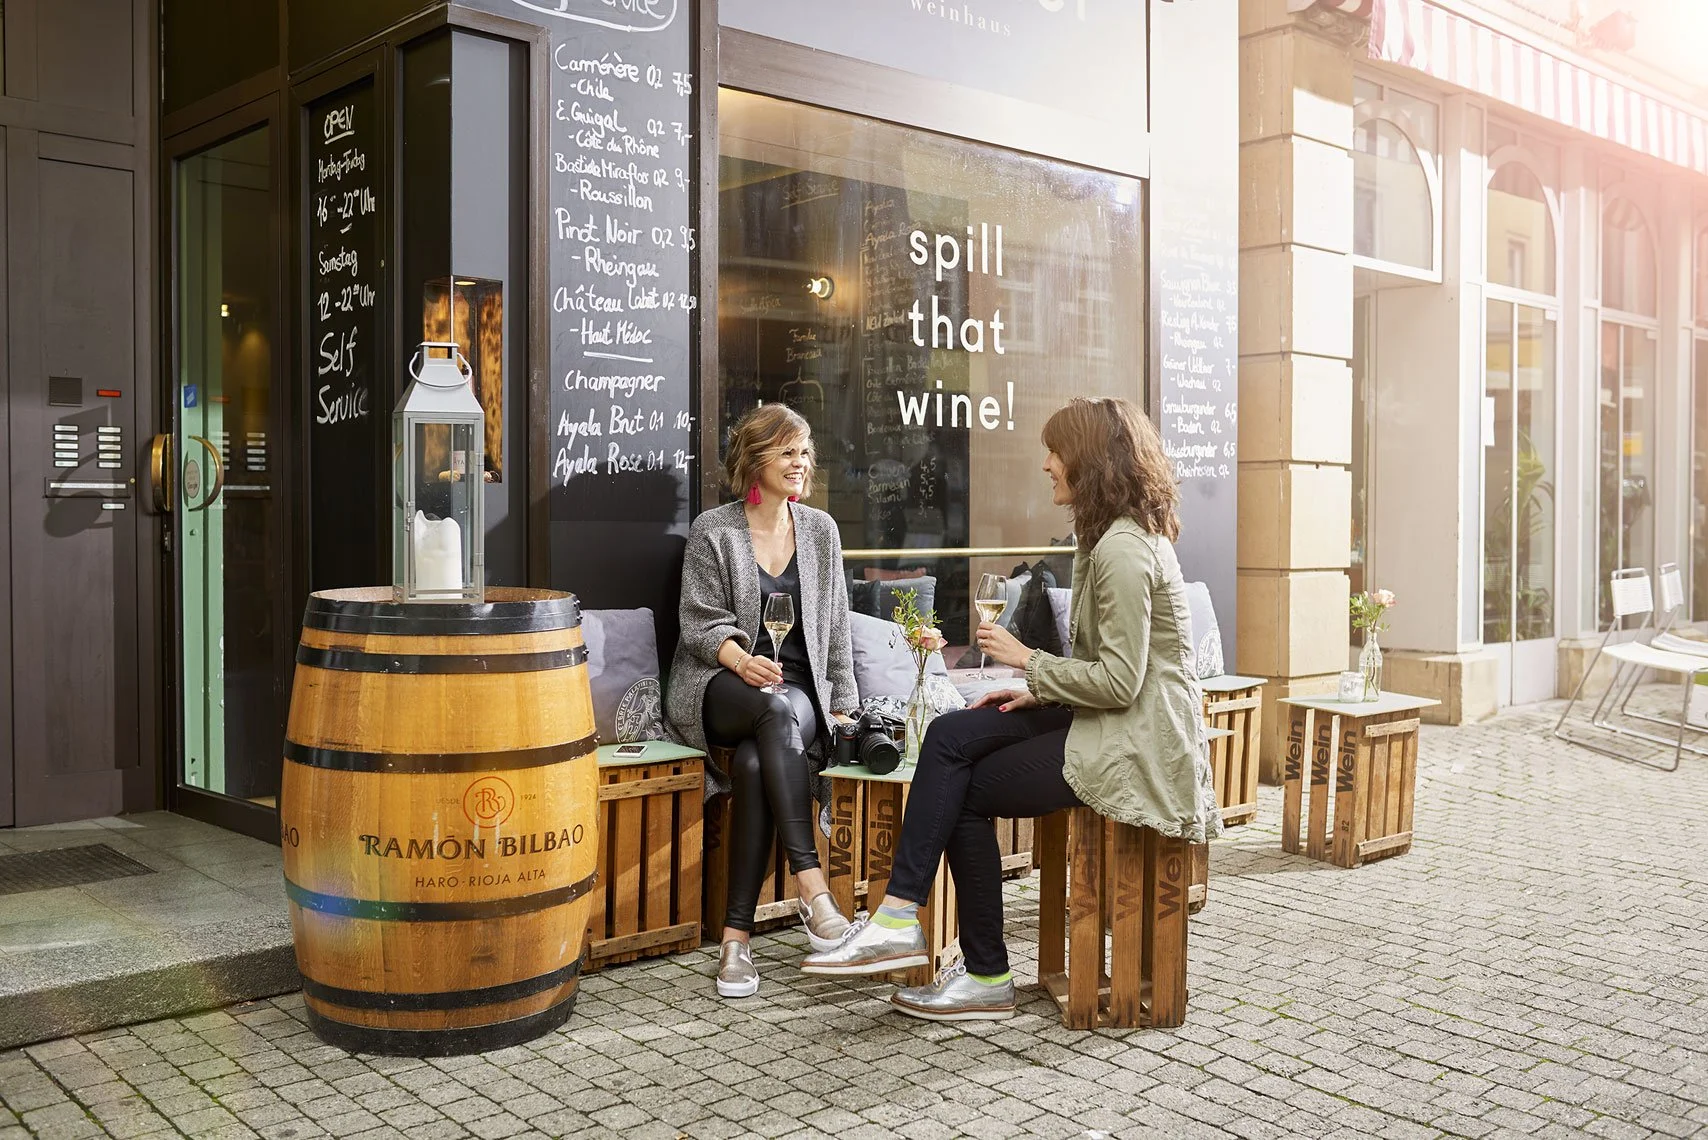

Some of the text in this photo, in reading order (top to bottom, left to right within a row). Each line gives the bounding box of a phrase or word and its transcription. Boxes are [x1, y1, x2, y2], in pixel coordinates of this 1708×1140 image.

[910, 0, 1011, 37] weinhaus
[323, 104, 354, 139] OPEN
[571, 101, 628, 138] Guigal
[606, 137, 623, 153] du
[622, 134, 660, 159] Rhône
[361, 186, 376, 216] Uhr
[554, 206, 601, 243] Pinot
[606, 213, 643, 245] Noir
[318, 246, 358, 277] Samstag
[909, 222, 1003, 282] spill
[359, 283, 376, 307] Uhr
[553, 283, 624, 313] Château
[908, 295, 1006, 355] that
[318, 326, 359, 378] Self
[316, 382, 371, 425] Service
[563, 369, 666, 399] Champagner
[897, 379, 1016, 431] wine!
[557, 408, 602, 451] Ayala
[608, 404, 645, 436] Brut
[552, 443, 599, 488] Ayala
[1285, 719, 1304, 781] Wein
[1311, 723, 1332, 786] Wein
[1336, 729, 1357, 793] Wein
[497, 823, 585, 858] BILBAO
[829, 794, 854, 879] Wein
[868, 798, 895, 883] Wein
[414, 868, 547, 889] HARO RIOJA ALTA
